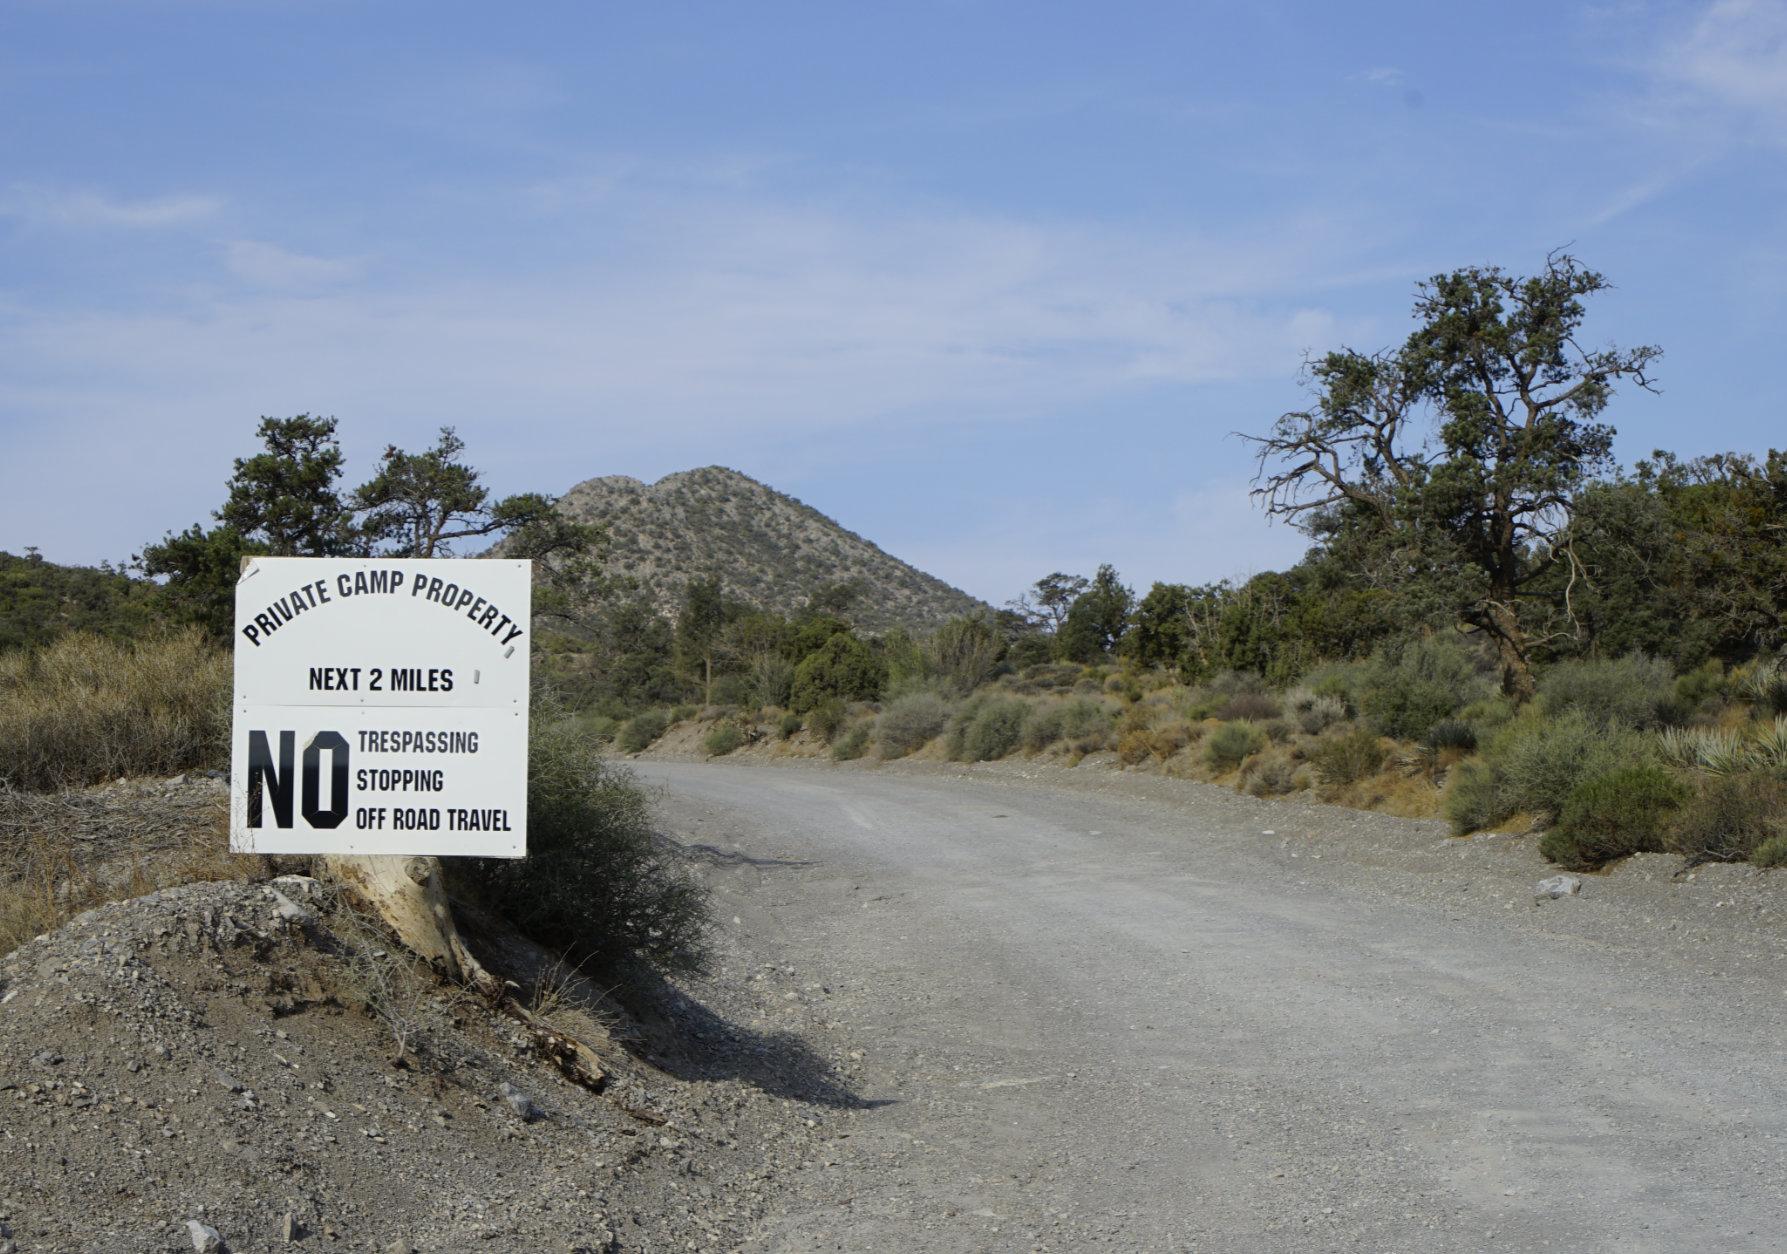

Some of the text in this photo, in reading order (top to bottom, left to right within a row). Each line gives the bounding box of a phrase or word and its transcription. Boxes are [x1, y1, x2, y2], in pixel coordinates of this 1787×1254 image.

[242, 570, 523, 647] PRIVATE CAMP PROPERTY
[309, 668, 453, 692] NEXT 2 MILES
[358, 730, 479, 754] TRESPASSING
[247, 730, 350, 830] NO
[356, 769, 444, 792] STOPPING
[356, 808, 512, 832] OFF ROAD TRAVEL
